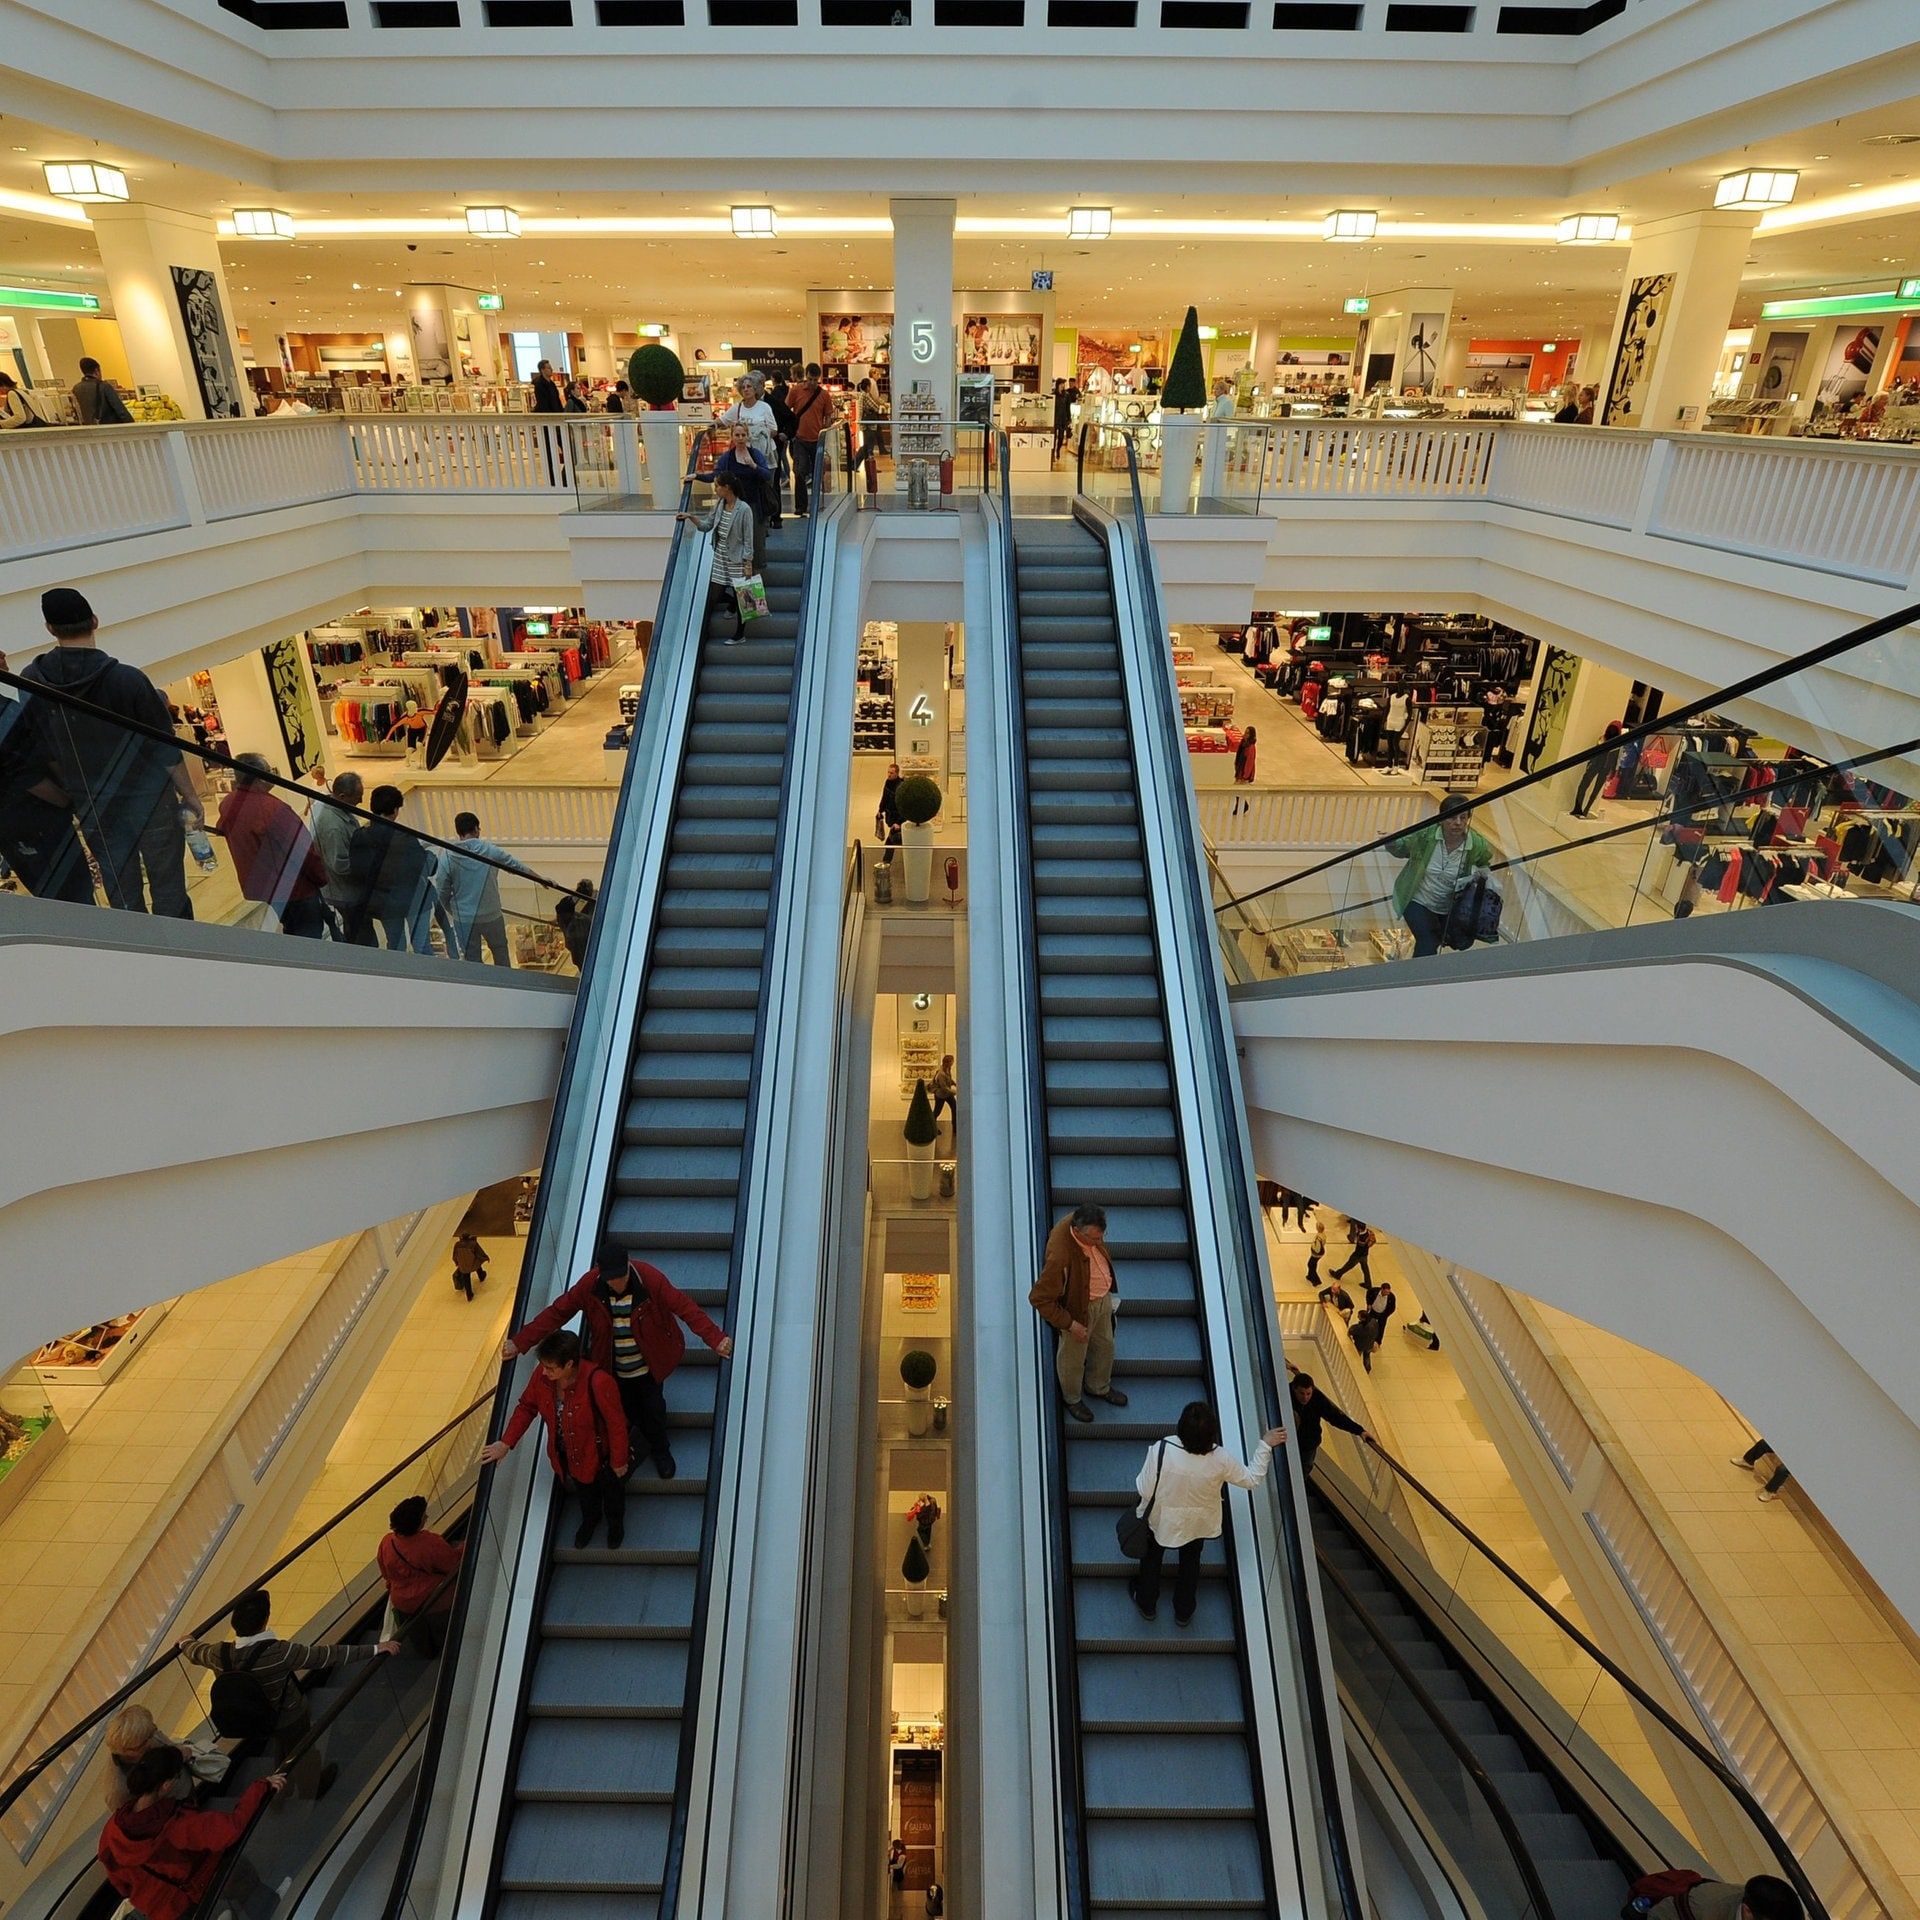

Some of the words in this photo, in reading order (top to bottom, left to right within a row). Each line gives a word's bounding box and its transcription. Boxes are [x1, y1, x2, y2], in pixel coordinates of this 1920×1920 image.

[913, 323, 933, 361] 5
[911, 696, 932, 726] 4
[914, 993, 929, 1010] 3
[908, 1822, 932, 1831] GALERIA
